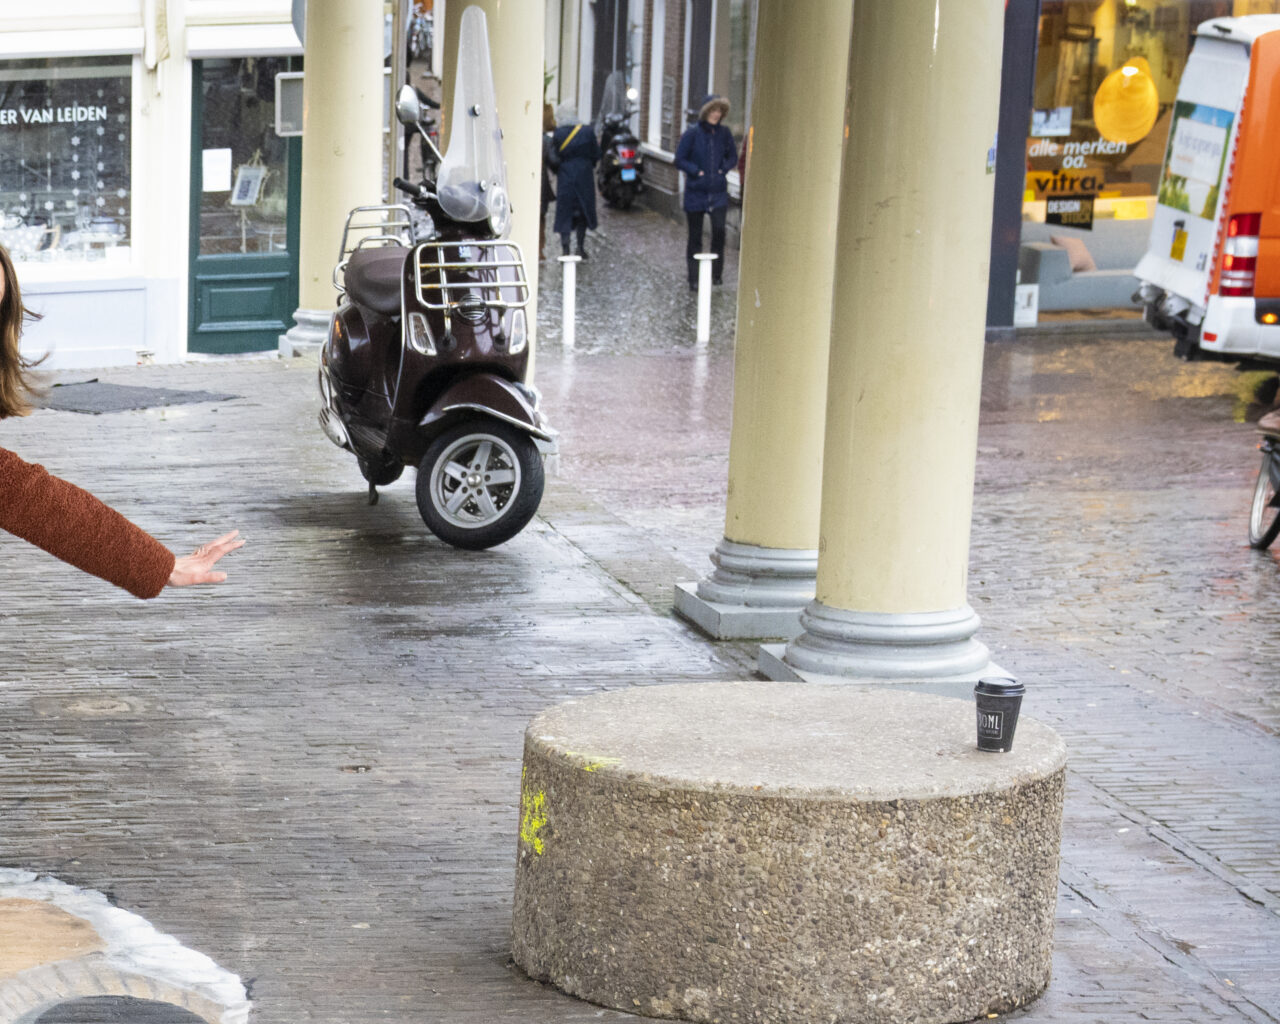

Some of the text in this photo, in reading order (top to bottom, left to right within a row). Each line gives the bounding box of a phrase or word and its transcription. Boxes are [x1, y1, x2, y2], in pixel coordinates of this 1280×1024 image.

[20, 107, 54, 124] VAN
[57, 105, 108, 122] LEIDEN
[1028, 137, 1127, 157] alle merken
[1047, 200, 1081, 214] DESIGN
